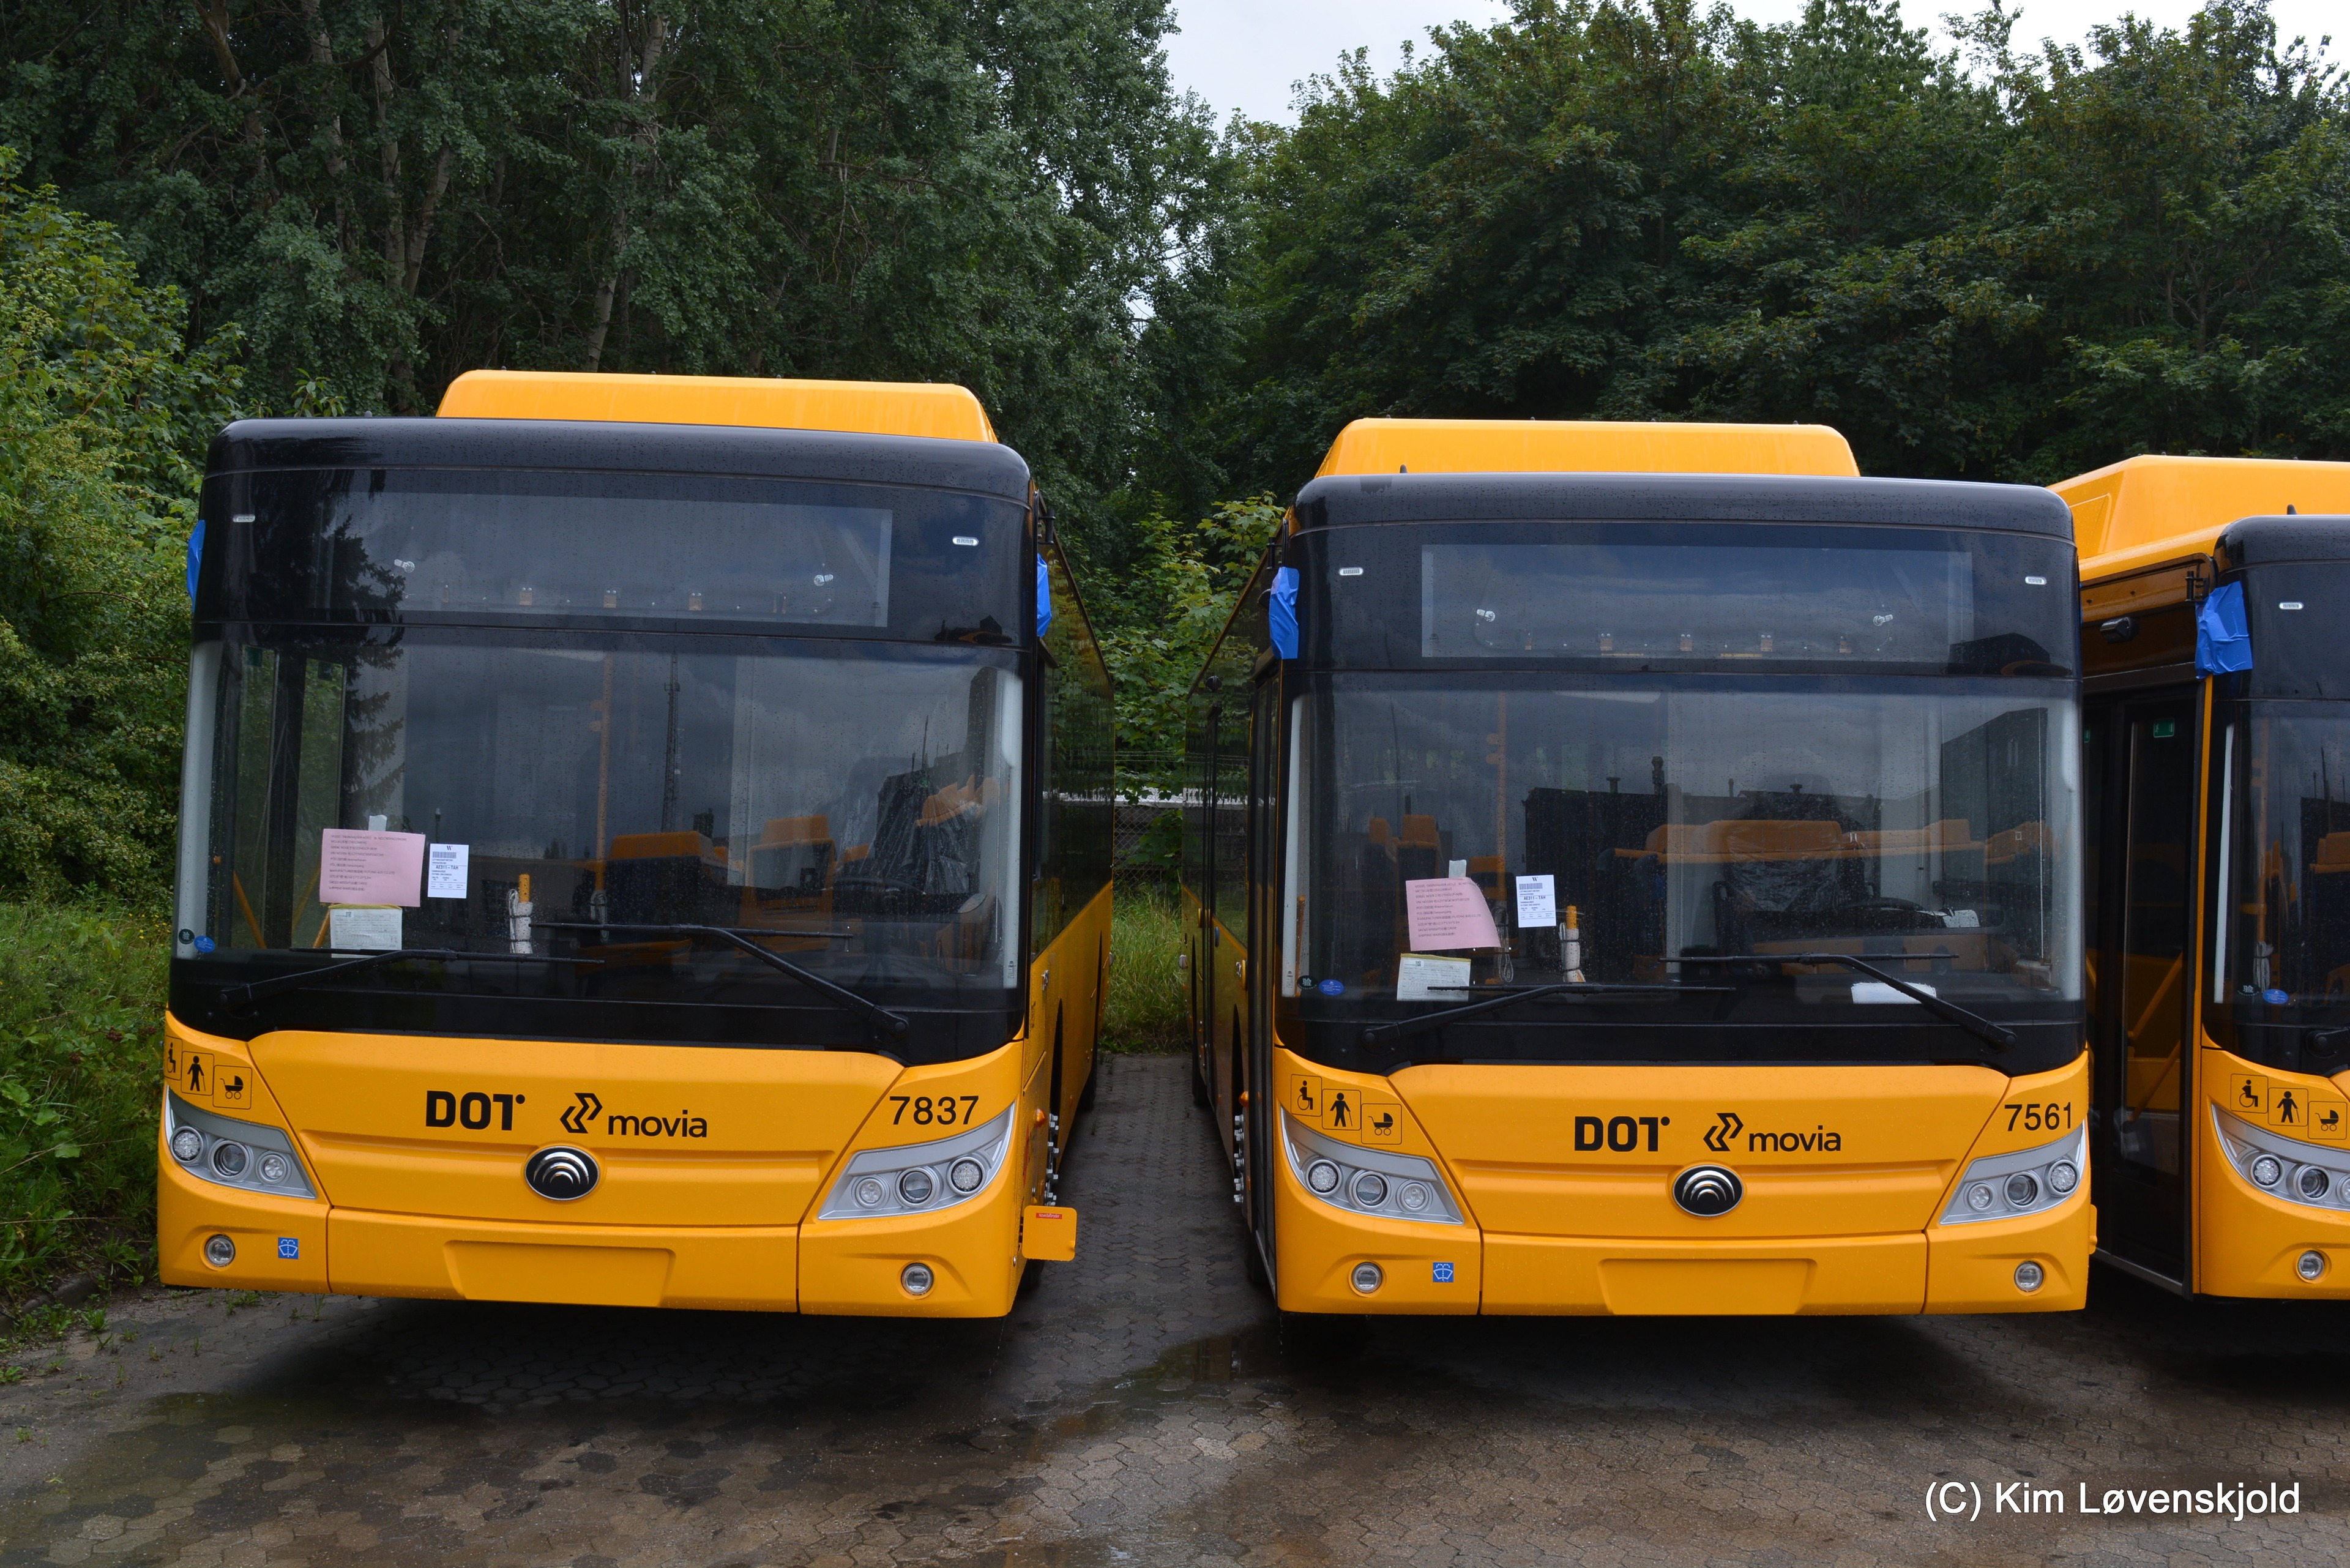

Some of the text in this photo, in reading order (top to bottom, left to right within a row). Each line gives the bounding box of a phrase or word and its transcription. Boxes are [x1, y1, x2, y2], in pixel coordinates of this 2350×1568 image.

[425, 1090, 525, 1131] DOT
[608, 1109, 707, 1137] movia
[889, 1095, 979, 1125] 7837
[2004, 1102, 2071, 1132] 7561
[1574, 1116, 1670, 1152] DOT
[1748, 1125, 1841, 1152] movia
